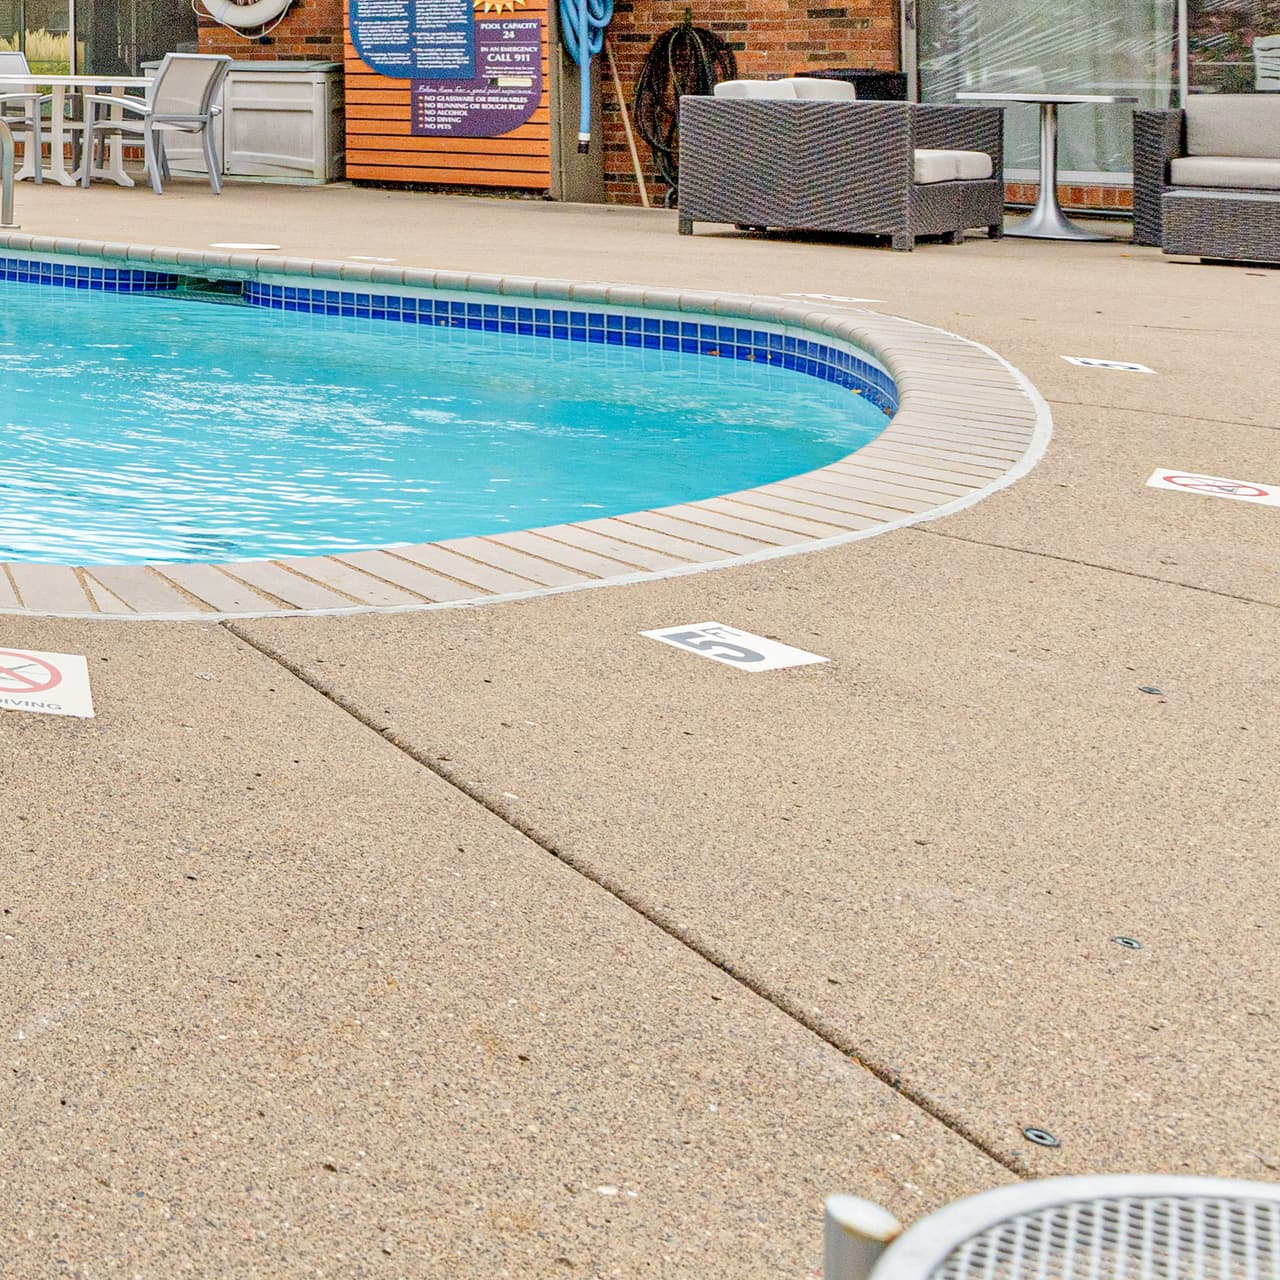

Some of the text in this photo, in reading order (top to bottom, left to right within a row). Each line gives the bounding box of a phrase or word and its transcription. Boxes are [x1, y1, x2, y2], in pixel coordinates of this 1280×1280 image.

[502, 30, 515, 39] 24
[487, 53, 530, 62] CALL 911
[660, 631, 766, 663] 5
